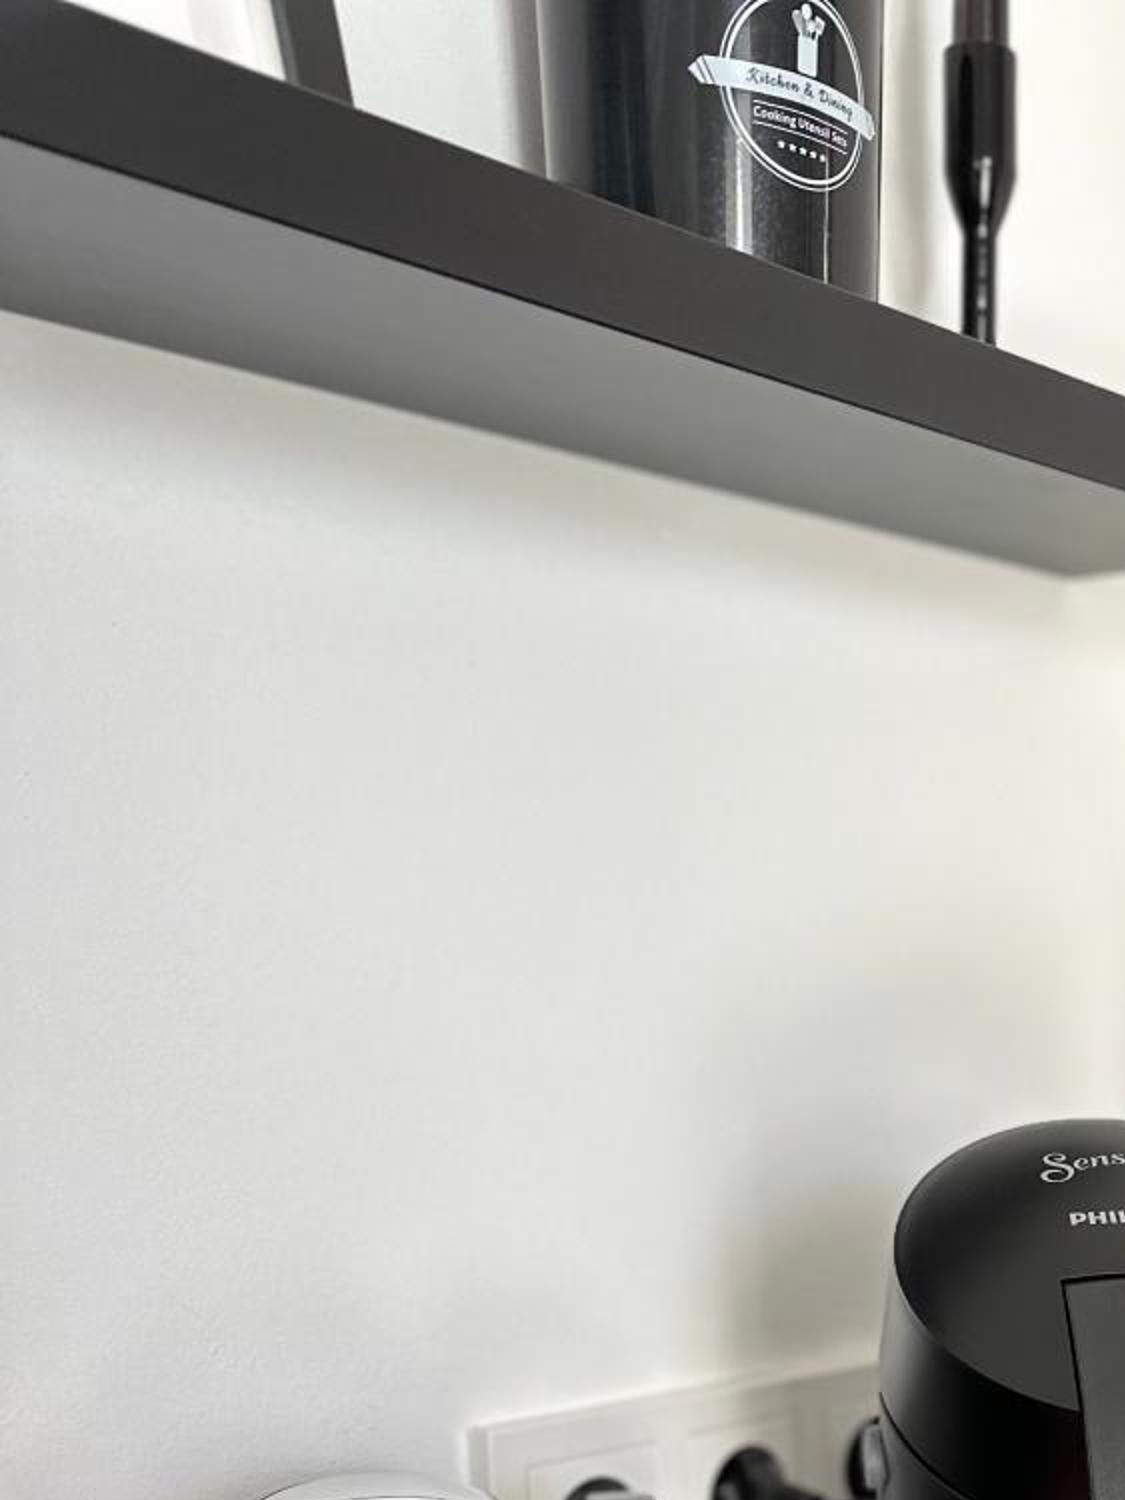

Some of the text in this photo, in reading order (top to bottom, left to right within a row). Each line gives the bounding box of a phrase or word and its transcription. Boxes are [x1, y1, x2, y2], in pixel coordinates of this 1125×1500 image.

[745, 67, 853, 122] Kitchen & Dining
[753, 105, 797, 128] Cooking
[798, 118, 831, 139] Utensil
